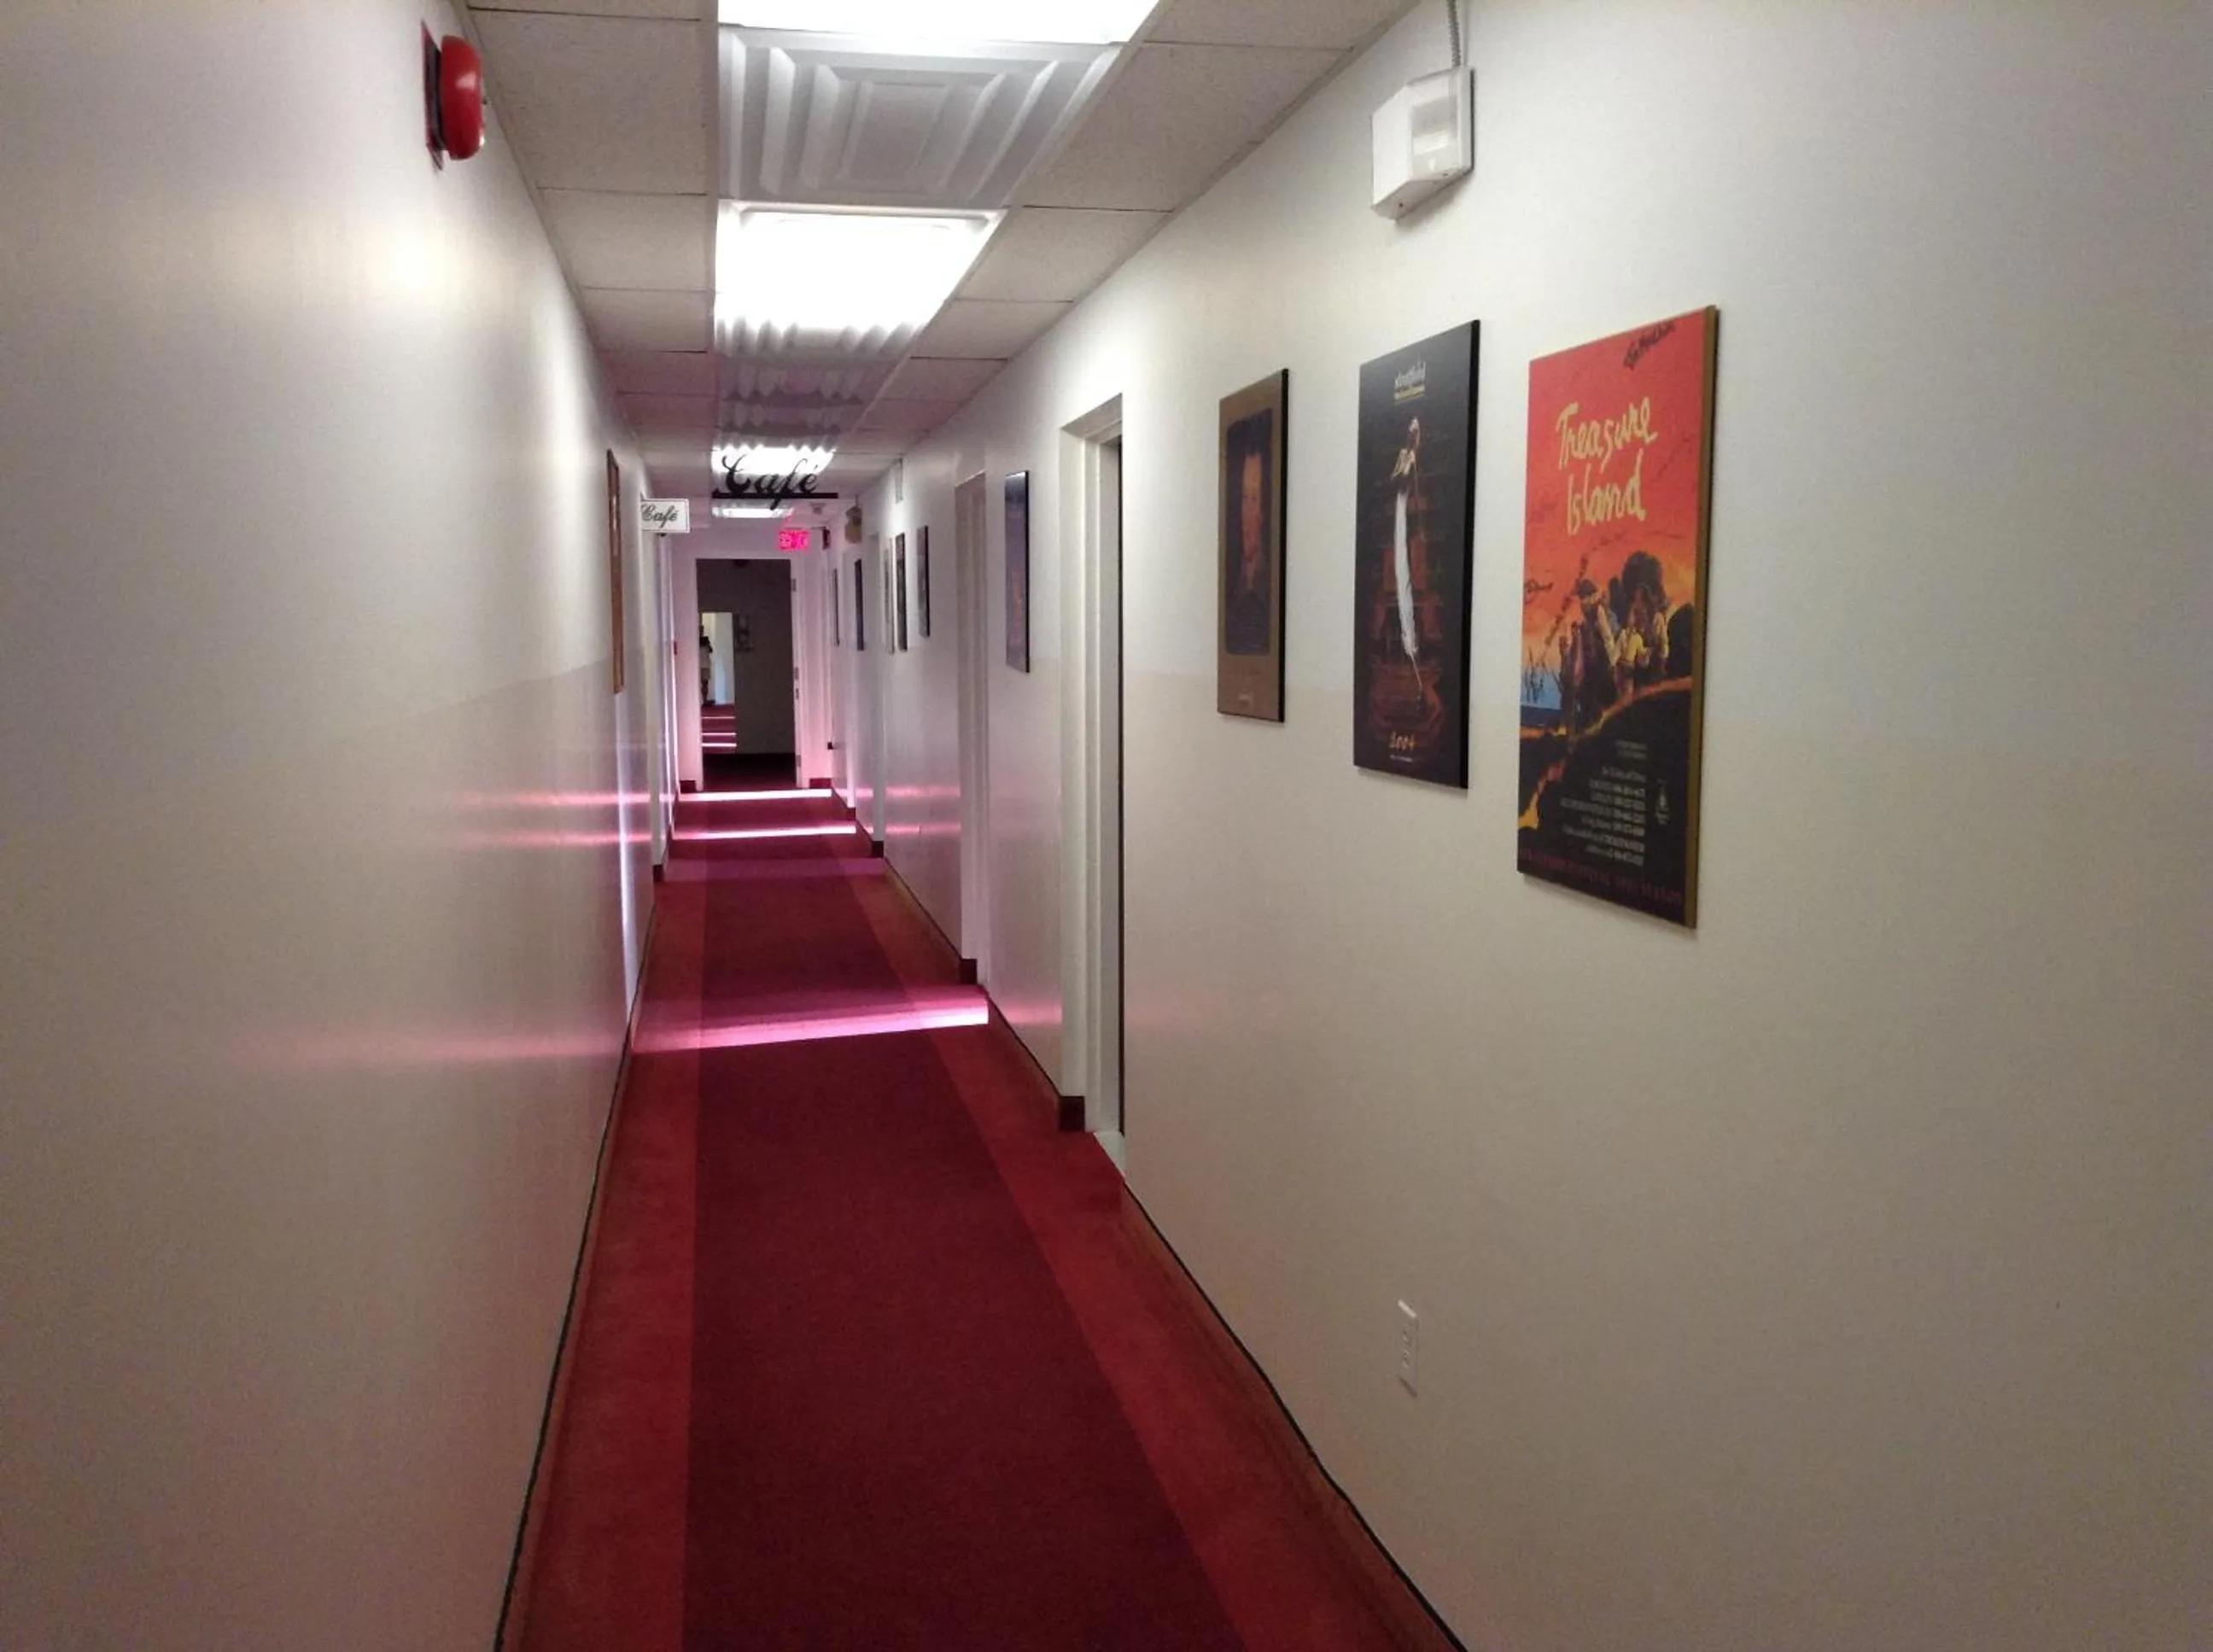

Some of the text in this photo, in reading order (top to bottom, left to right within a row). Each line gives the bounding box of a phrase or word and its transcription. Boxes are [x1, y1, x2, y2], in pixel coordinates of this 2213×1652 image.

[1556, 396, 1658, 473] Treasure
[721, 454, 819, 510] Café
[1568, 448, 1647, 534] Island
[640, 504, 680, 528] Café
